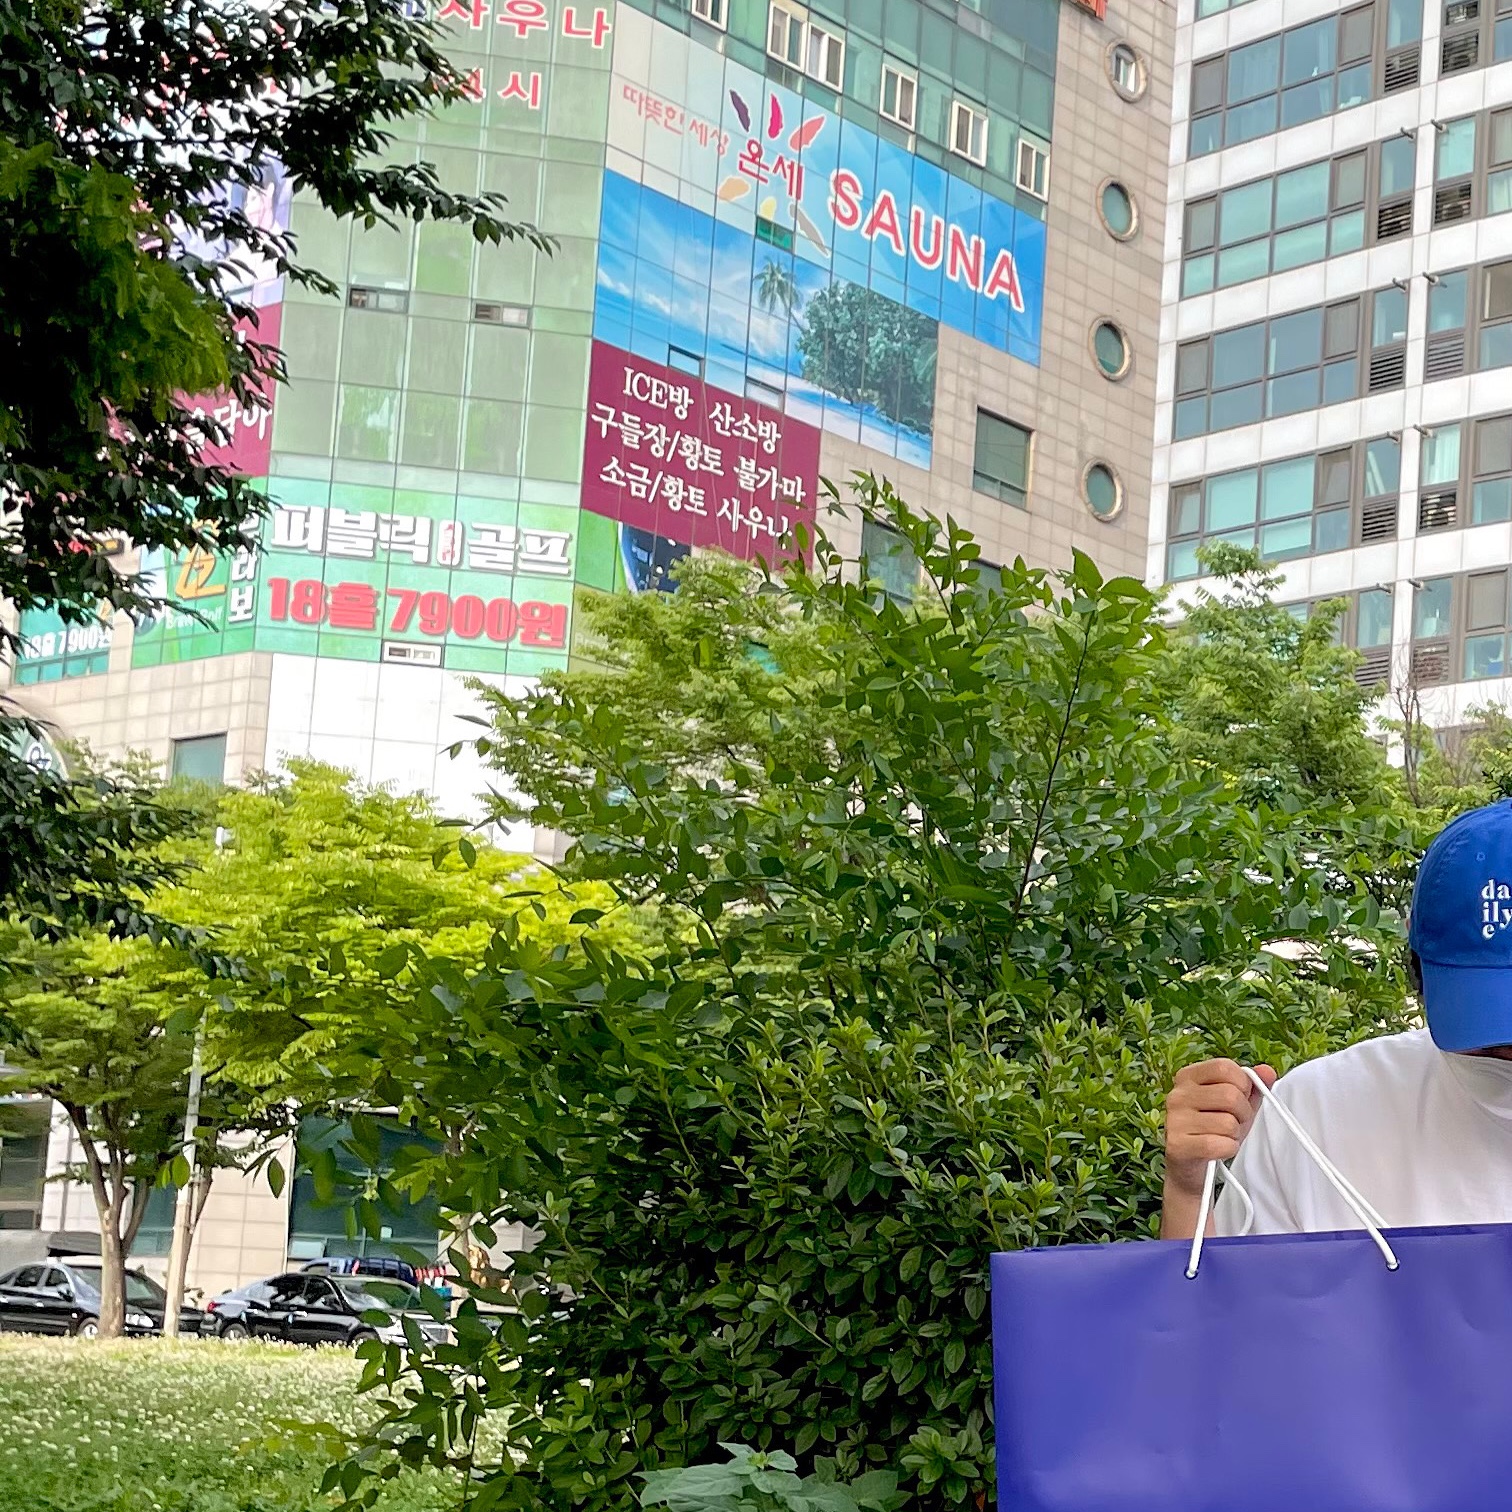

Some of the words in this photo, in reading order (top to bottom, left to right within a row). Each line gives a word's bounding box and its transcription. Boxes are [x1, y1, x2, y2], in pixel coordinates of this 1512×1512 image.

[437, 0, 612, 48] 사우나
[623, 84, 685, 136] 따뜻한
[689, 118, 730, 157] 세상
[737, 138, 804, 201] 온세
[828, 168, 1025, 313] SAUNA
[622, 366, 694, 420] ICE방
[709, 402, 782, 454] 산소방
[591, 402, 725, 477] 구들장/황토
[733, 455, 806, 510] 불가마
[599, 456, 708, 517] 소금/황토
[270, 503, 433, 565] 퍼블릭
[466, 521, 574, 577] 골프
[267, 577, 380, 632] 18홀
[386, 588, 570, 650] 7900원
[1481, 878, 1511, 900] da
[1482, 923, 1496, 940] e
